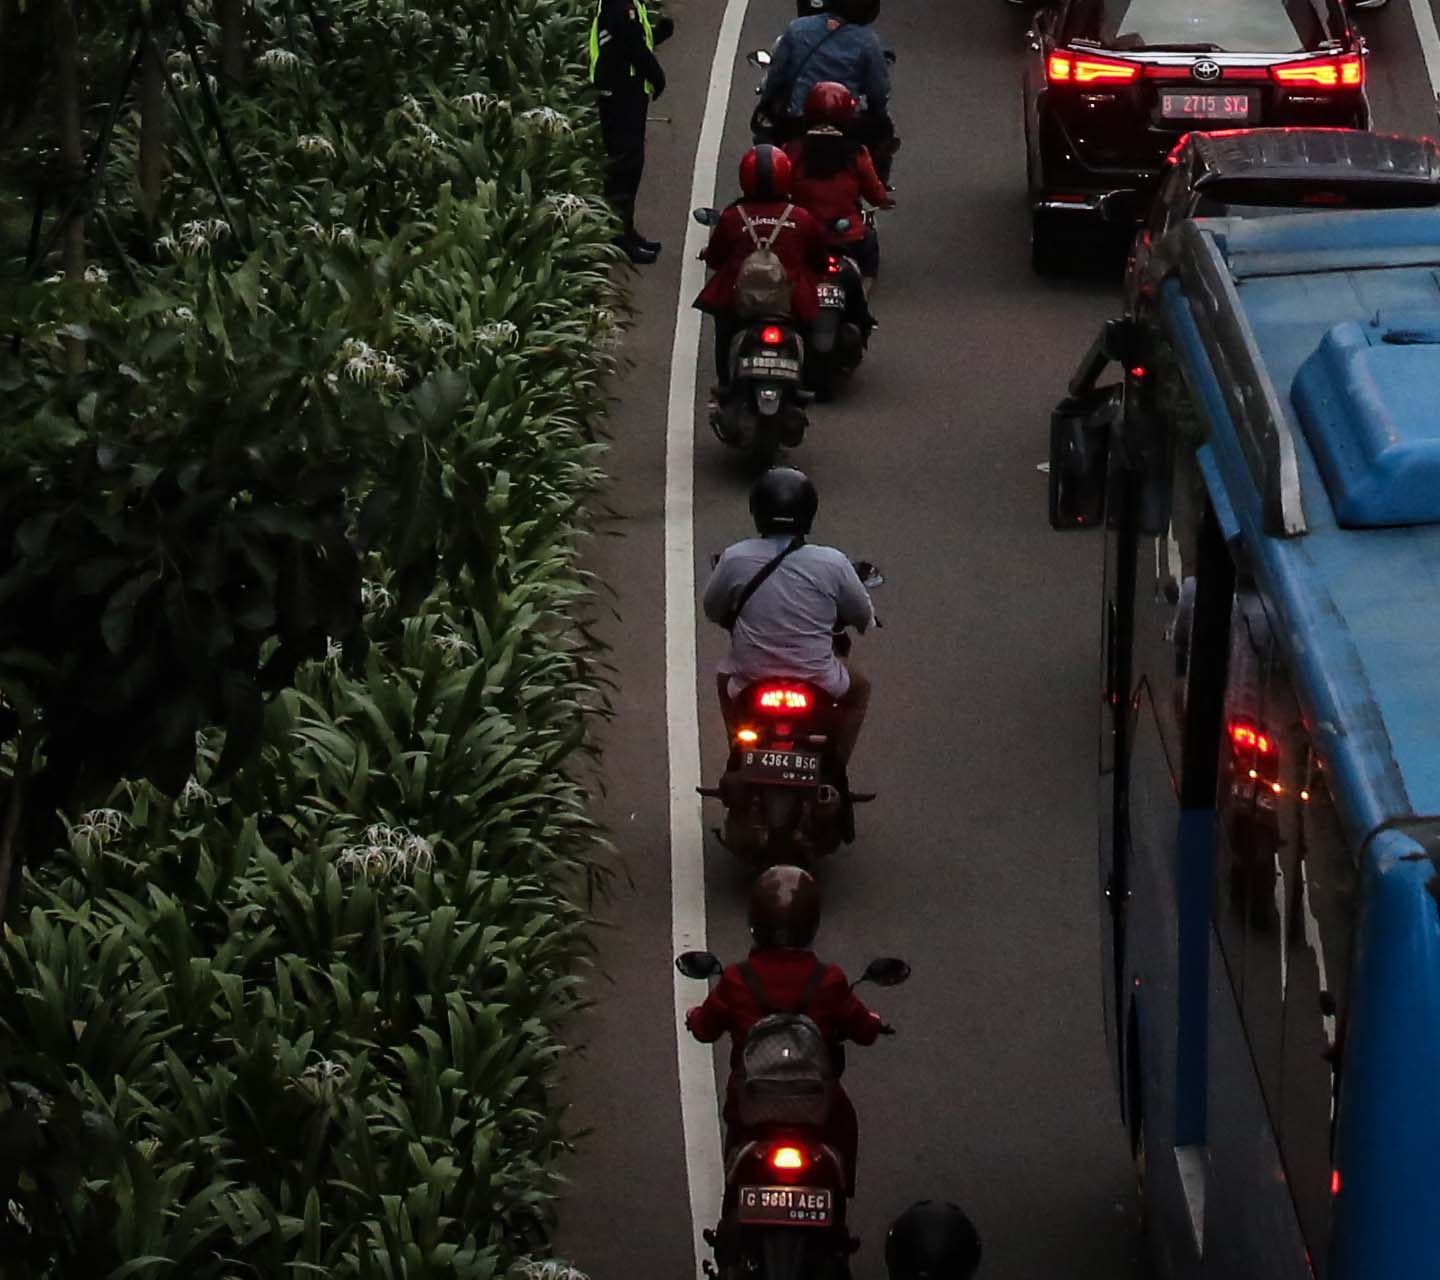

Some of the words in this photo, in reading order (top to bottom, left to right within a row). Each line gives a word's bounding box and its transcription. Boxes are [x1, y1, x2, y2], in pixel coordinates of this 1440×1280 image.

[1161, 95, 1172, 112] B
[1183, 95, 1216, 112] 2715
[1223, 95, 1249, 113] SYJ
[746, 752, 754, 765] B
